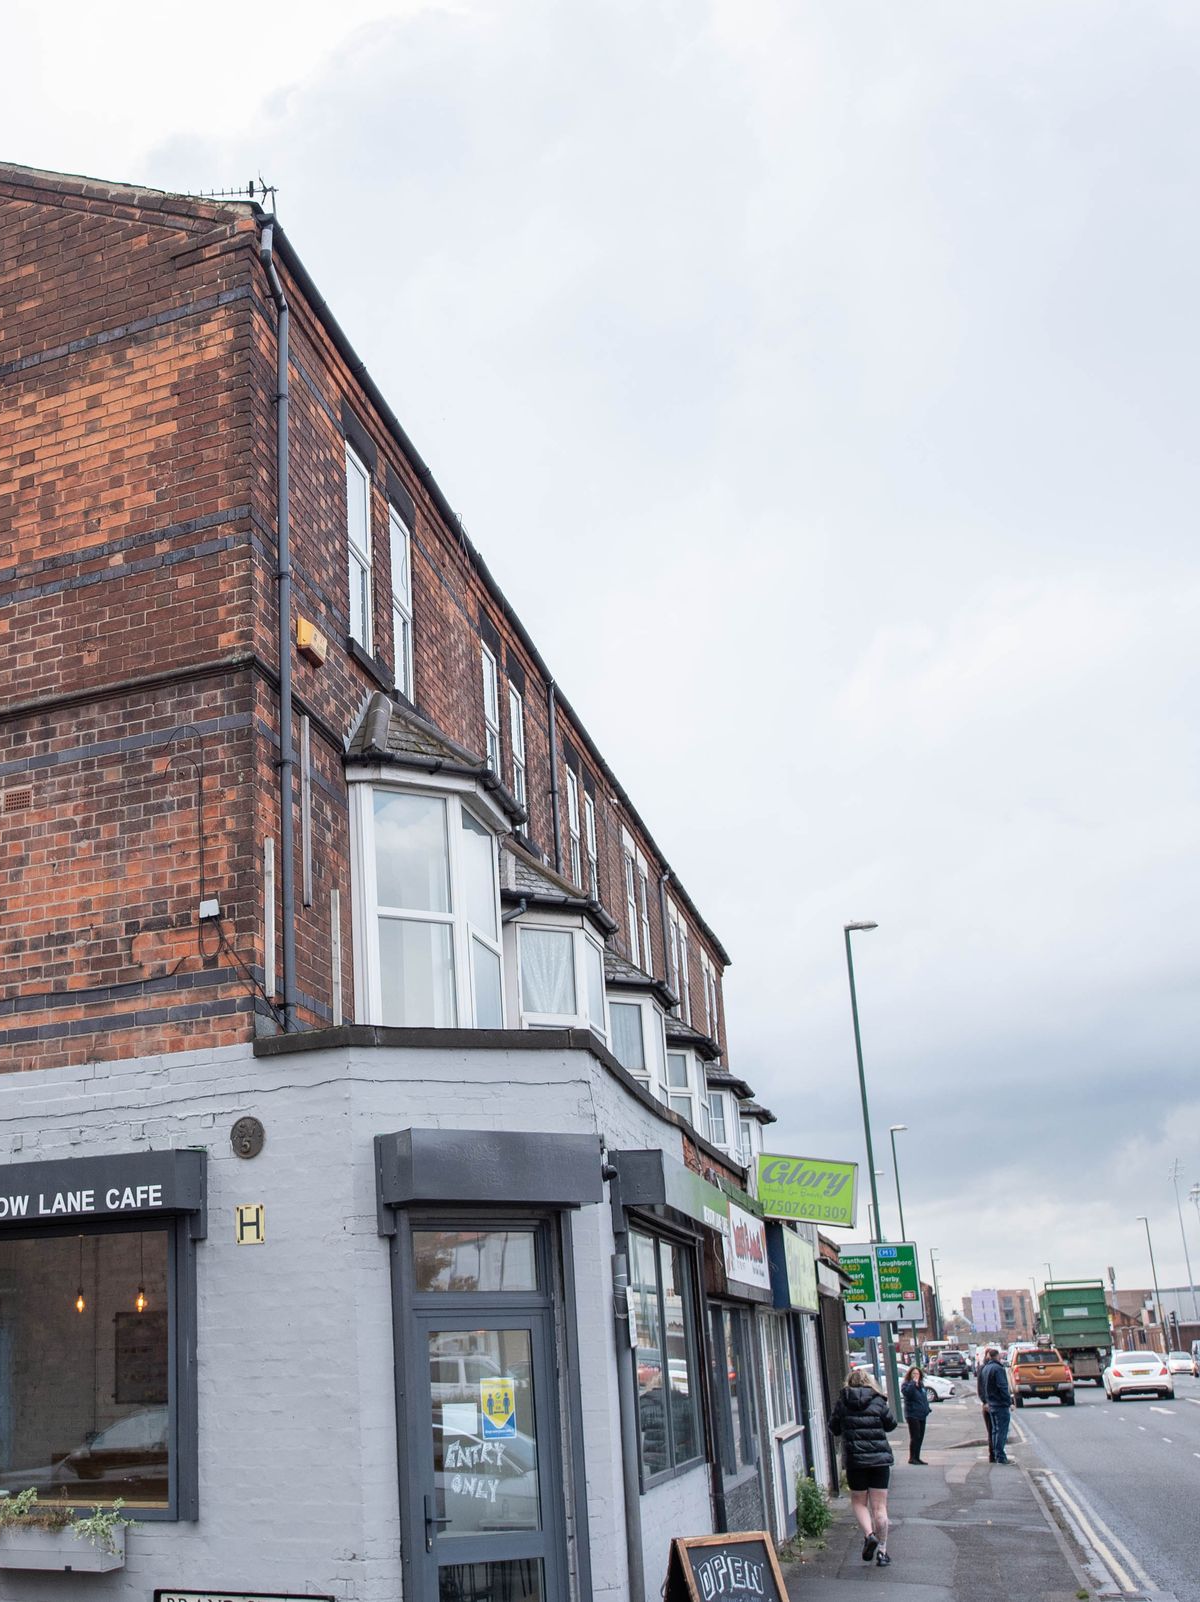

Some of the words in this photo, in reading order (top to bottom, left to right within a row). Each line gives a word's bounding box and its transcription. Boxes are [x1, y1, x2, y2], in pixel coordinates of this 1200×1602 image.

[241, 1137, 251, 1152] 5
[762, 1160, 851, 1197] Glory
[38, 1189, 95, 1215] LANE
[105, 1184, 163, 1210] CAFE
[239, 1207, 260, 1241] H
[444, 1440, 506, 1469] ENTRY
[451, 1473, 500, 1503] ONLY
[698, 1554, 764, 1601] OPEN
